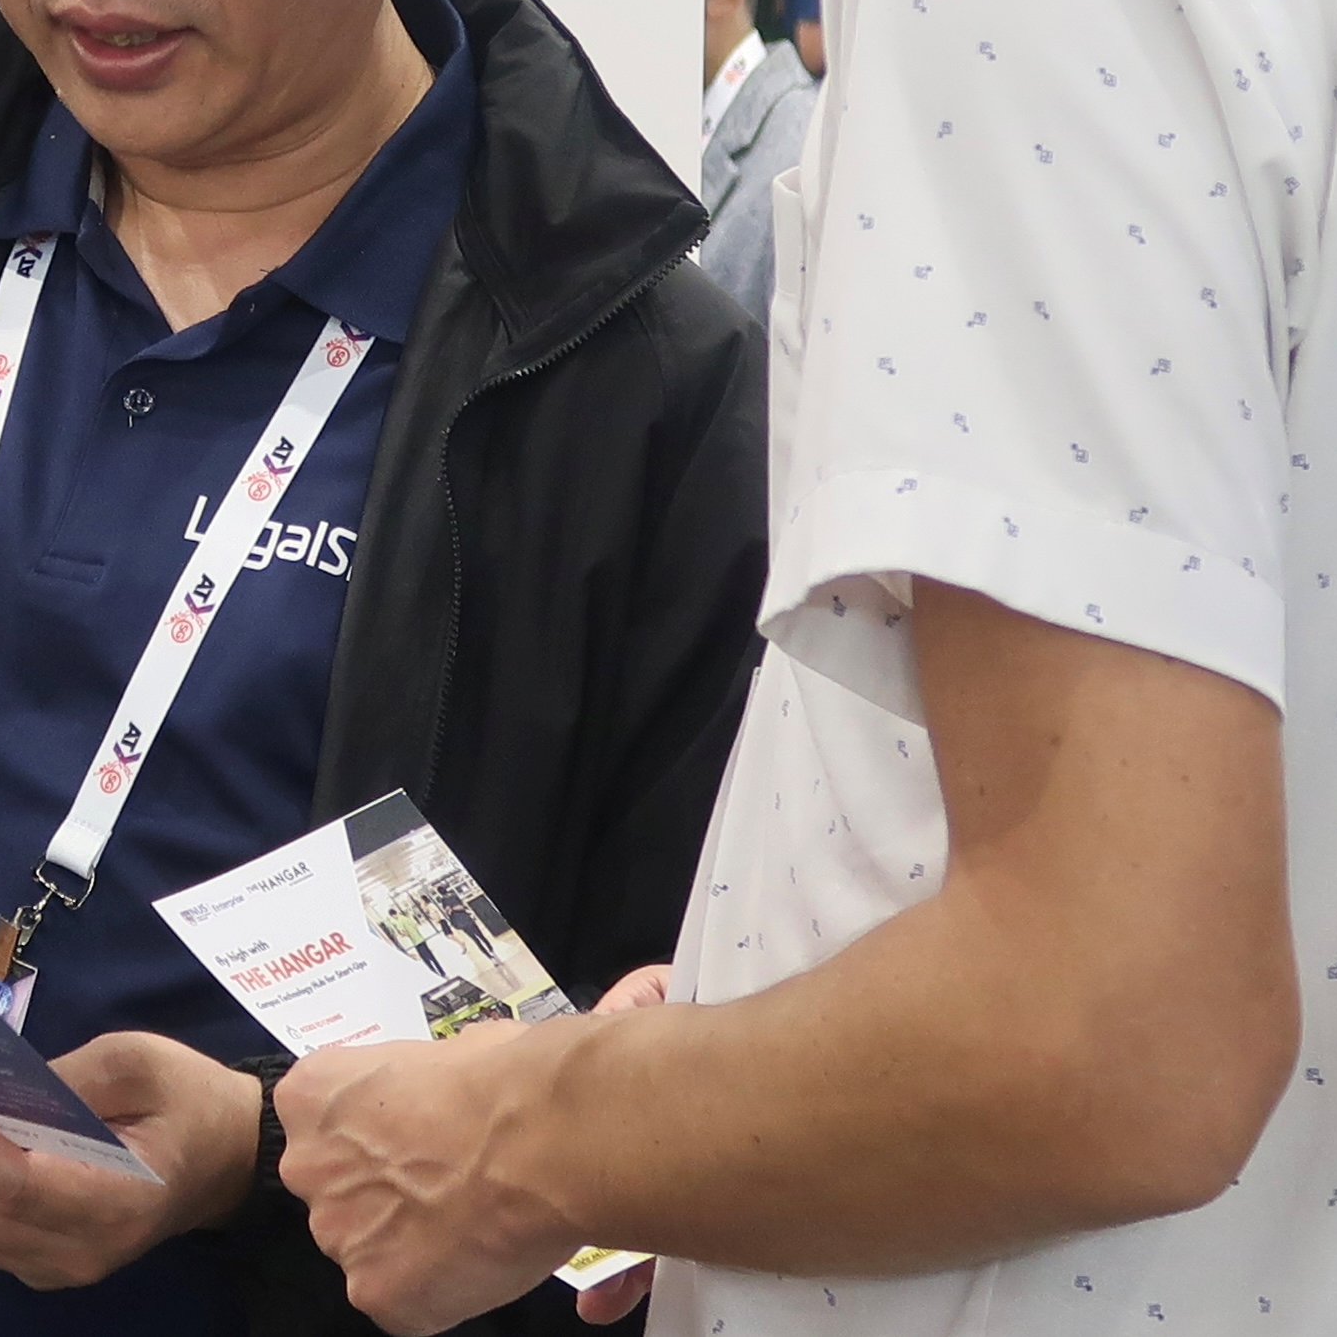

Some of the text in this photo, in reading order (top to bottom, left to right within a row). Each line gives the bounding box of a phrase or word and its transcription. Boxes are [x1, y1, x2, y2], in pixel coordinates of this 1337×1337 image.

[257, 861, 310, 893] HANGAR
[228, 947, 250, 963] high
[249, 939, 270, 955] with
[230, 931, 354, 994] THE HANGAR
